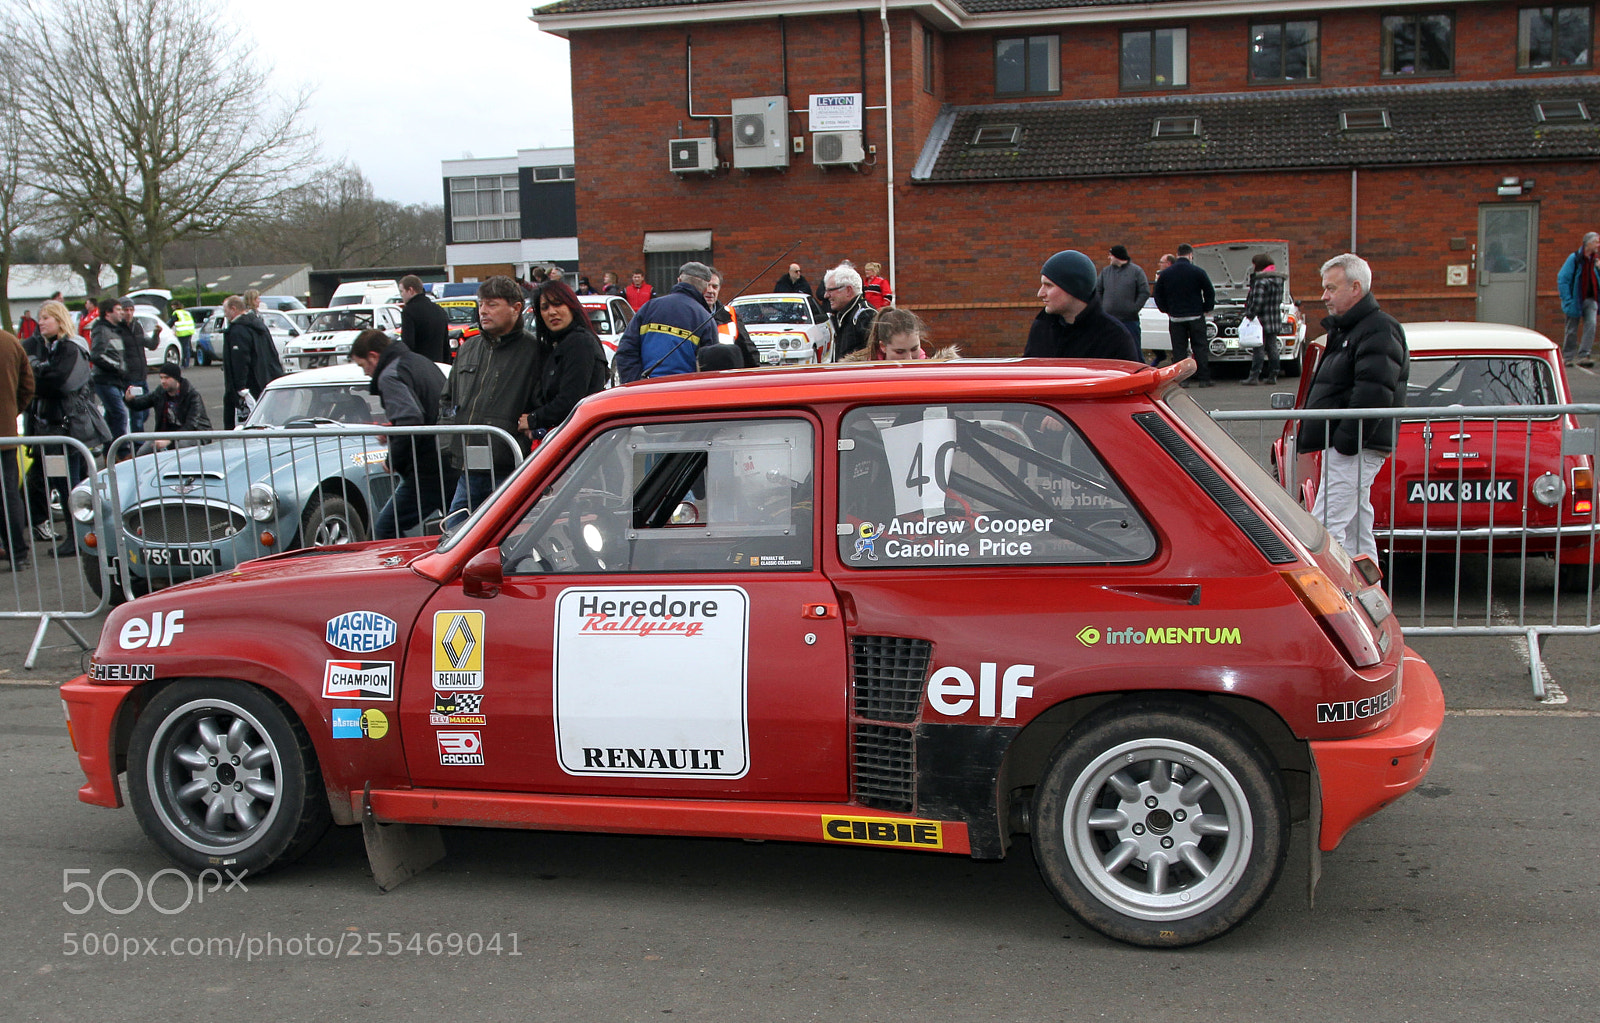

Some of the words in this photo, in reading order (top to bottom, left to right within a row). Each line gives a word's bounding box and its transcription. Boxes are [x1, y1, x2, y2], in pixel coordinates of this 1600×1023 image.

[818, 97, 853, 105] LEYTON
[1461, 481, 1513, 501] 816K
[888, 517, 965, 535] Andrew
[974, 515, 1054, 536] Cooper
[143, 549, 171, 565] 759
[178, 549, 213, 565] LOK
[885, 540, 970, 558] Caroline
[979, 539, 1032, 556] Price
[579, 594, 718, 618] Heredore
[119, 609, 184, 649] elf
[327, 612, 396, 638] MAGNETI
[581, 612, 704, 637] Rallying
[327, 631, 396, 651] MARELLI
[1106, 627, 1242, 644] infoMENTUM
[89, 663, 155, 680] CHELIN
[332, 673, 388, 687] CHAMPION
[439, 673, 477, 686] RENAULT
[927, 662, 1035, 719] elf
[332, 718, 361, 728] BILSTEIN
[449, 716, 485, 724] MARCHAL
[442, 754, 482, 764] FACOM
[582, 748, 724, 770] RENAULT
